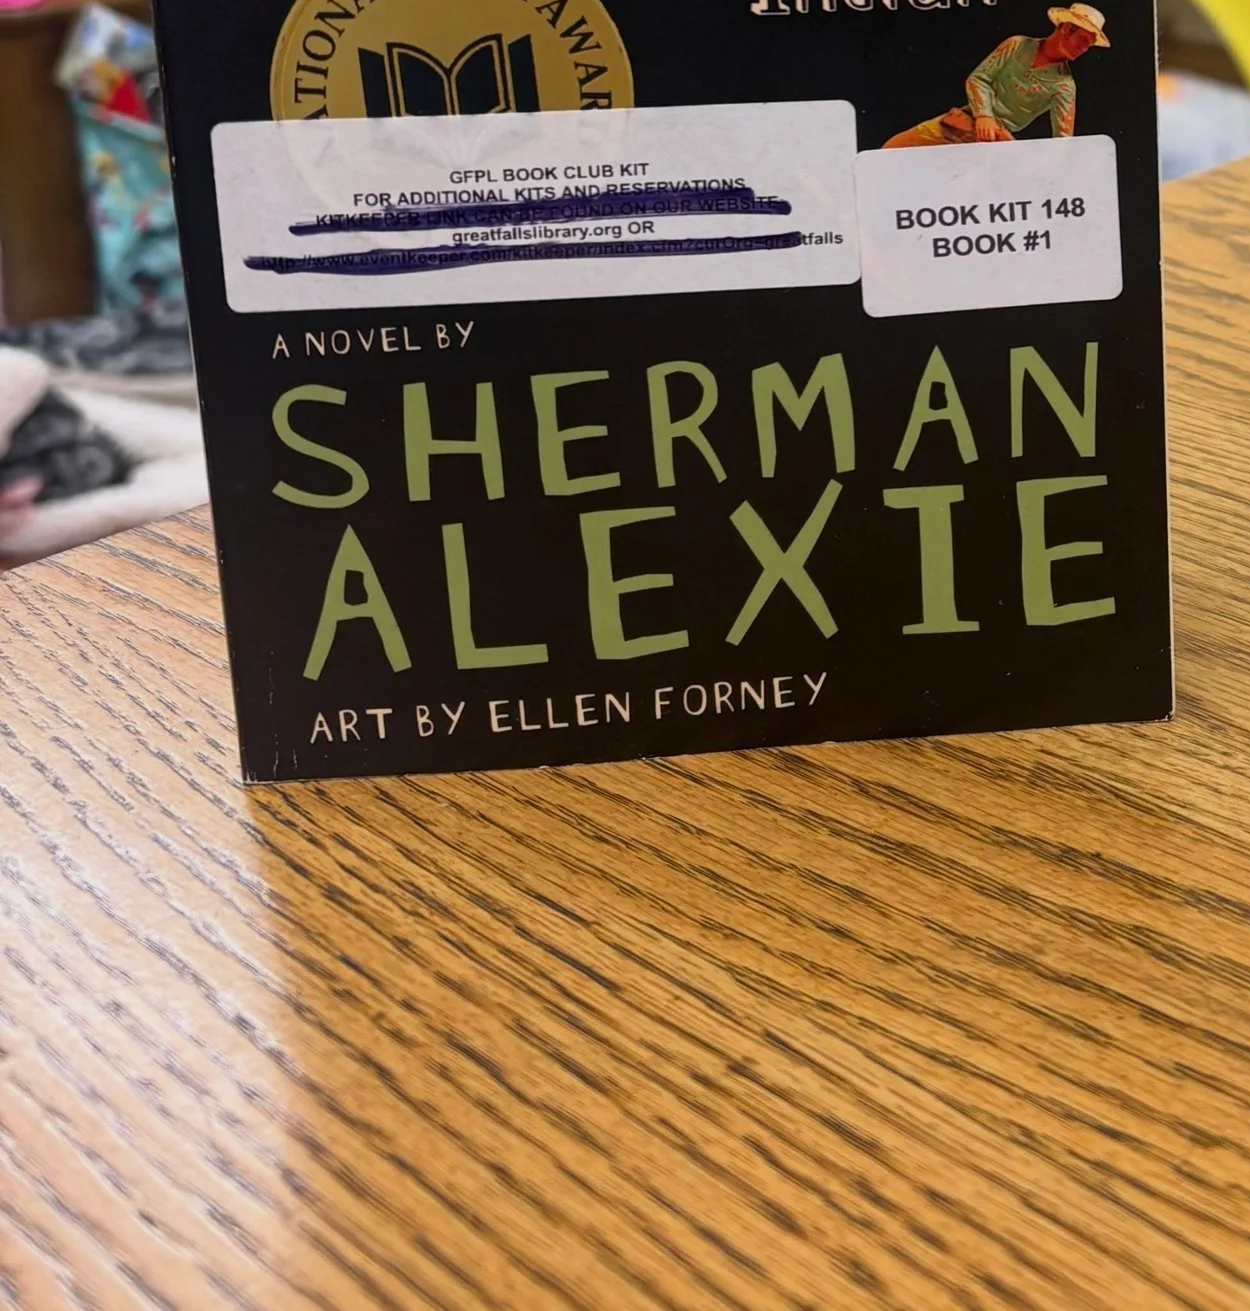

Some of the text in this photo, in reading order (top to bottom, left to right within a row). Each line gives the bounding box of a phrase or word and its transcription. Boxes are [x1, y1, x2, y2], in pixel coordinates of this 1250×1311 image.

[449, 163, 650, 184] GFPL BOOK CLUB KIT
[353, 178, 746, 206] FOR ADDITIONAL KITS AND RESERVATIONS
[895, 197, 1086, 230] BOOK KIT 148
[452, 220, 655, 244] greatfallslibrary.org OR
[932, 230, 1052, 258] BOOK #1
[272, 320, 476, 359] A NOVEL BY
[271, 341, 1100, 509] SHERMAN
[302, 478, 1117, 681] ALEXIE
[310, 671, 828, 745] ART BY ELLEN FORNEY
